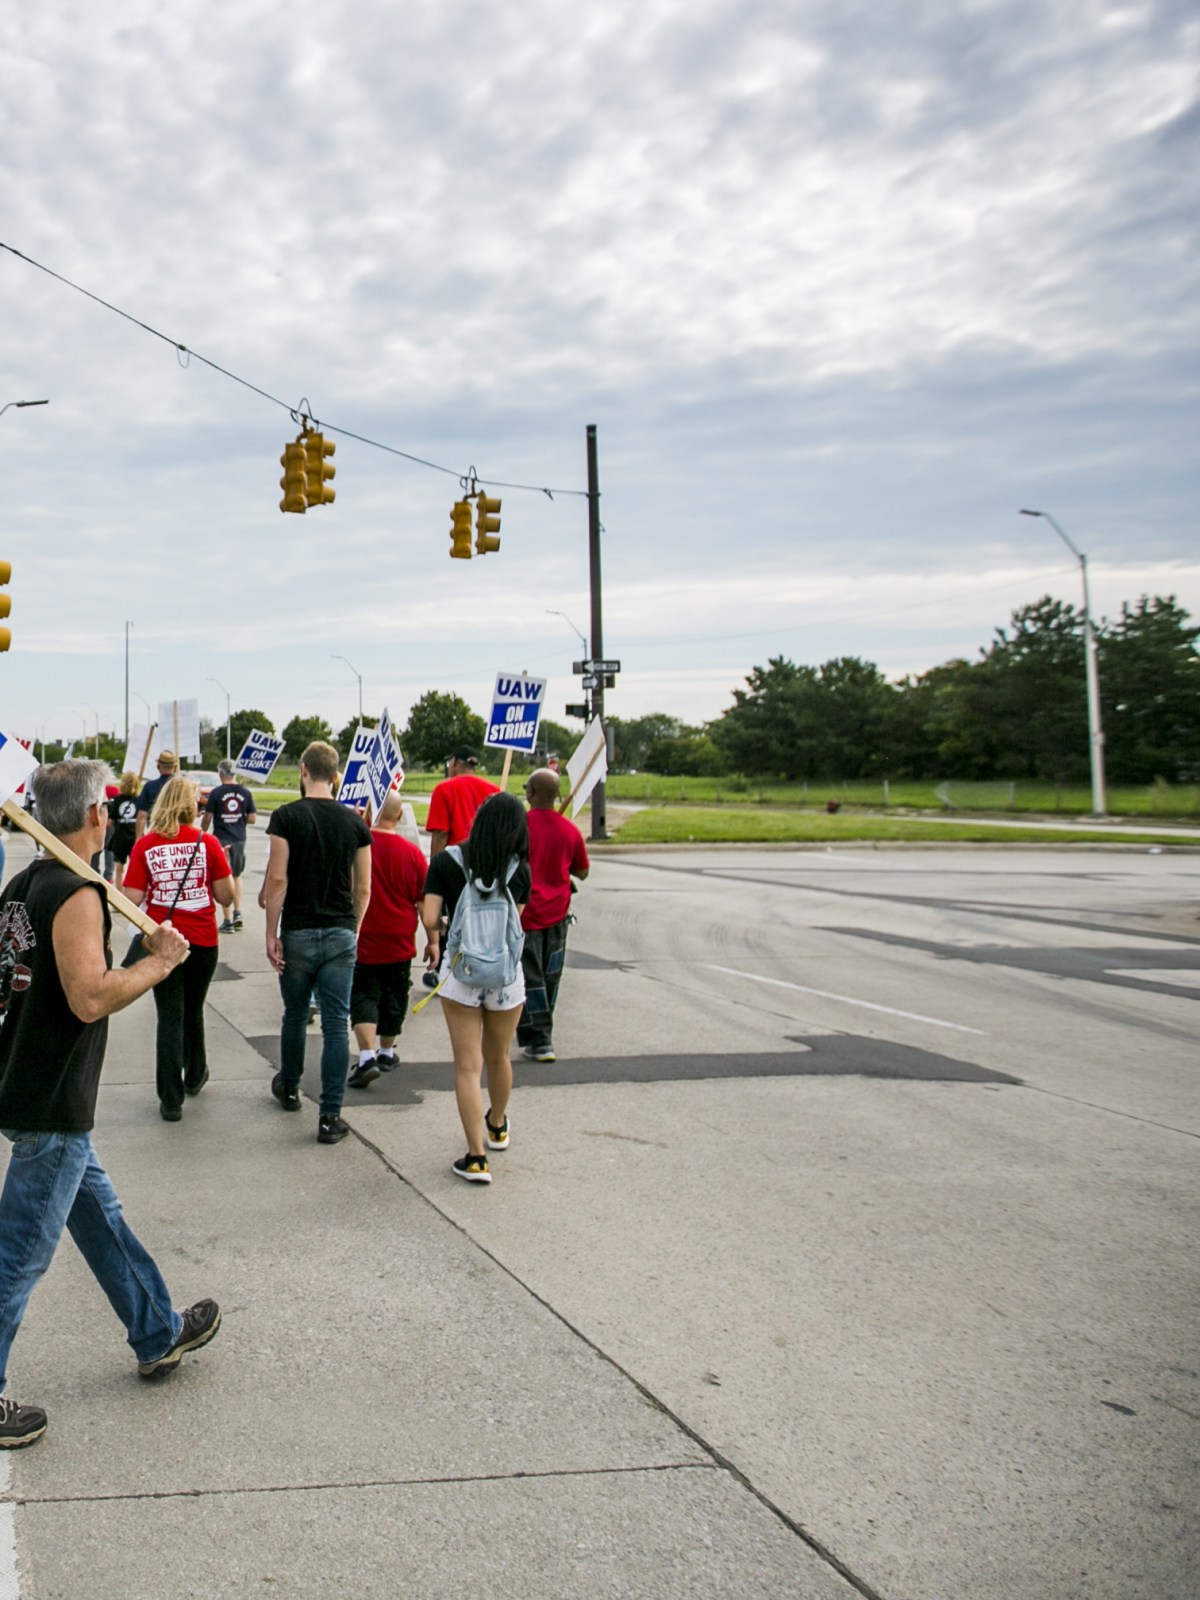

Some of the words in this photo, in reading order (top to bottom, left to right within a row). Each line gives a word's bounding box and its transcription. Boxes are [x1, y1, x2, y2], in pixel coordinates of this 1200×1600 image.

[497, 678, 543, 700] UAW
[505, 705, 525, 723] ON
[489, 721, 535, 742] STRIKE
[251, 732, 281, 751] UAW
[355, 734, 375, 755] UA
[237, 759, 273, 769] STRIKE
[251, 750, 267, 760] ON
[340, 782, 370, 801] STRI
[149, 846, 167, 861] ONE
[151, 859, 168, 871] ONE
